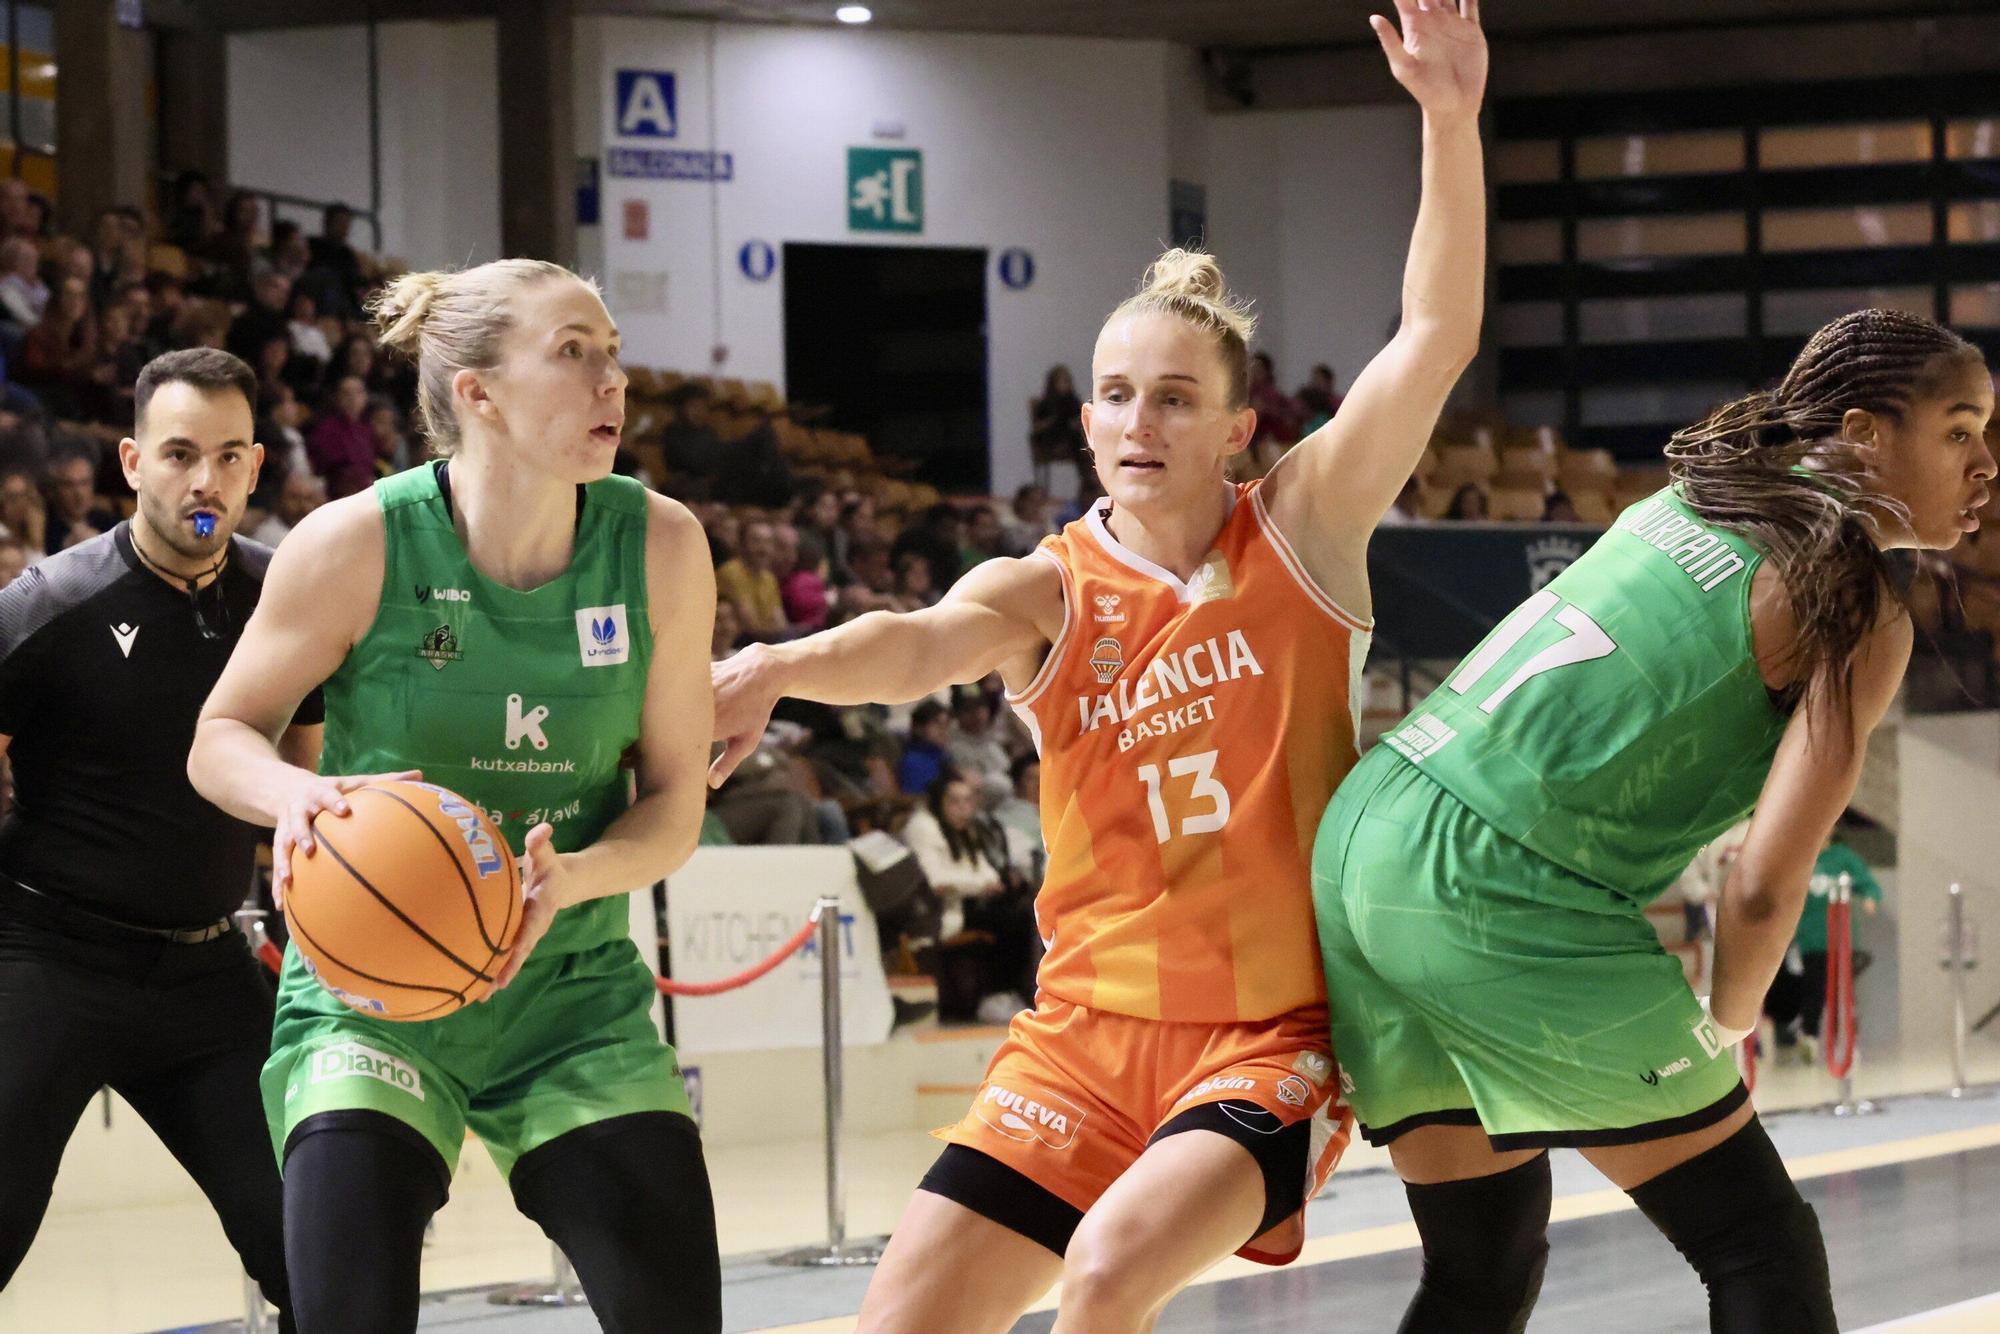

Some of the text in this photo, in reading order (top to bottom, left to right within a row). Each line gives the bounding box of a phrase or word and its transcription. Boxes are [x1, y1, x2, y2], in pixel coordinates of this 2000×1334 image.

[622, 76, 673, 132] A
[433, 588, 471, 602] WIBO
[1448, 589, 1619, 715] 17
[1117, 695, 1215, 753] BASKET
[471, 757, 576, 773] kutxabank
[1138, 750, 1230, 845] 13
[319, 1046, 415, 1089] Diario
[984, 1085, 1068, 1135] PULEVA
